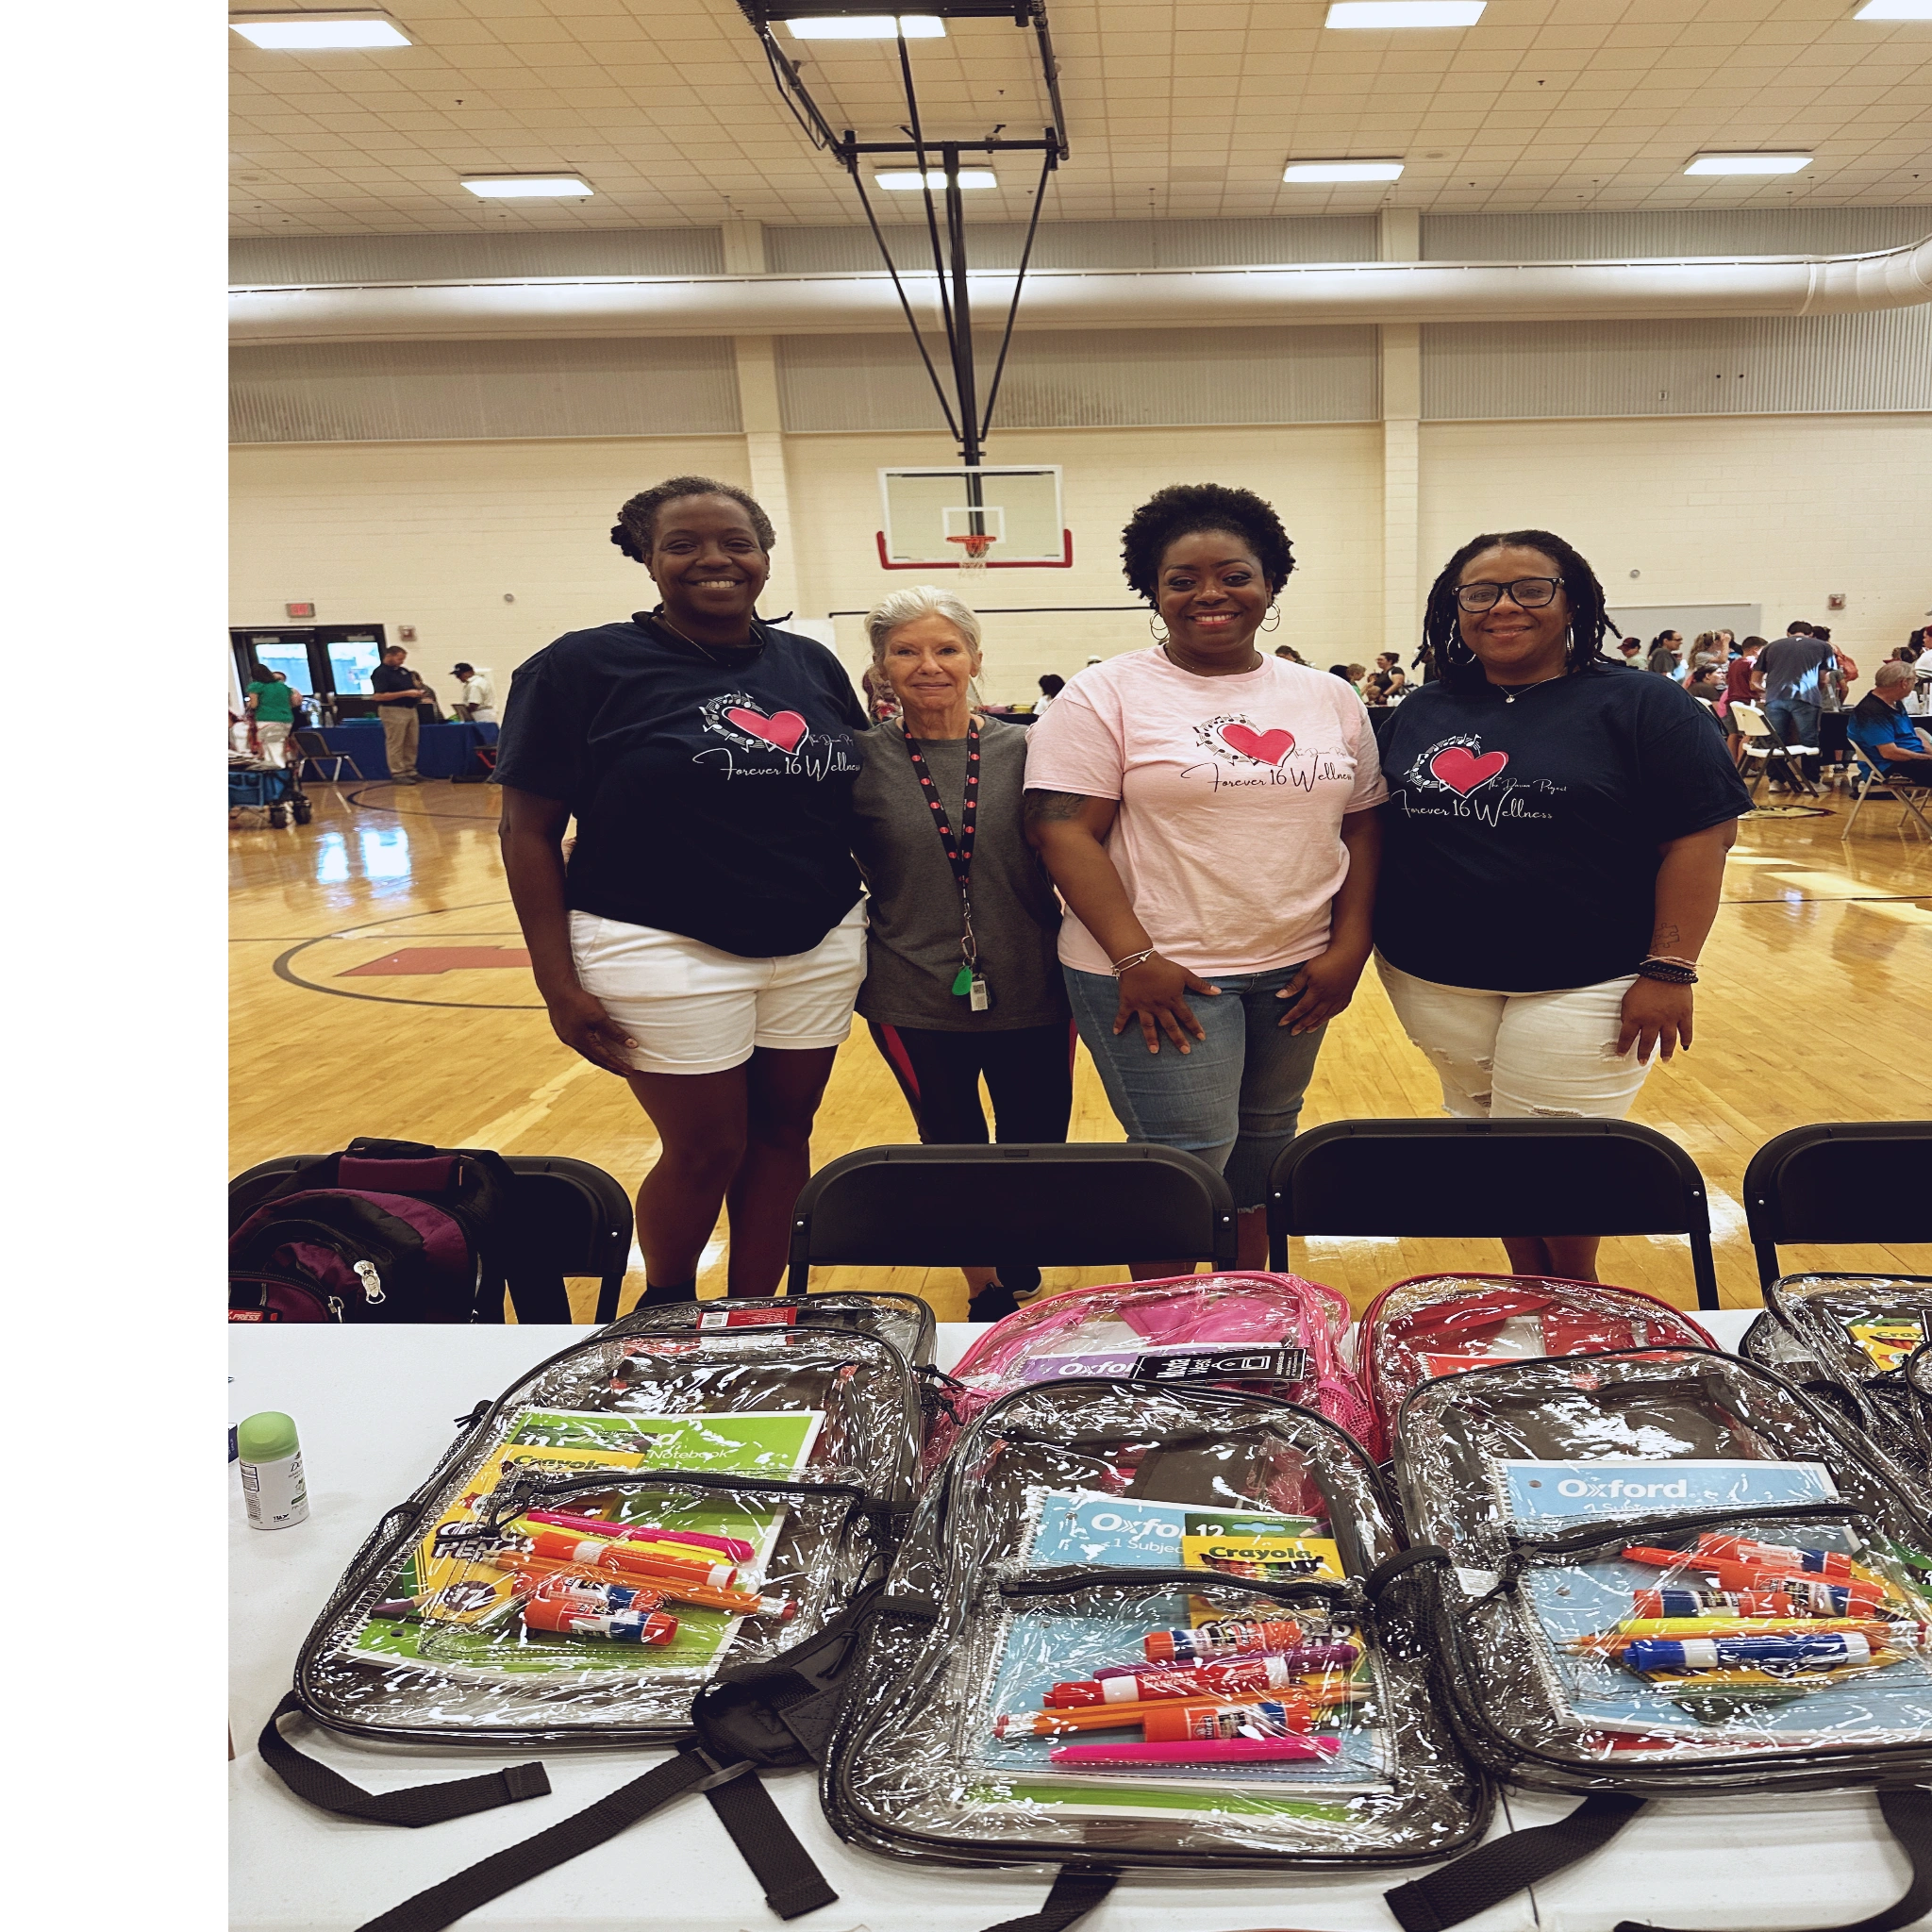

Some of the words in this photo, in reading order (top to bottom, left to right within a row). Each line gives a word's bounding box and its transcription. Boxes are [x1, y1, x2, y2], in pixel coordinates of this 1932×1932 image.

[691, 748, 782, 781] Forever
[785, 757, 802, 774] 16
[1180, 762, 1267, 792] Forever
[1270, 769, 1287, 786] 16
[1391, 790, 1450, 818] Forever
[1453, 798, 1471, 817] 16
[1474, 788, 1553, 827] Wellness
[1557, 1478, 1688, 1500] Oxford
[1091, 1512, 1186, 1539] Oxfo
[1126, 1538, 1184, 1554] Subjec
[1208, 1545, 1313, 1560] Crayola
